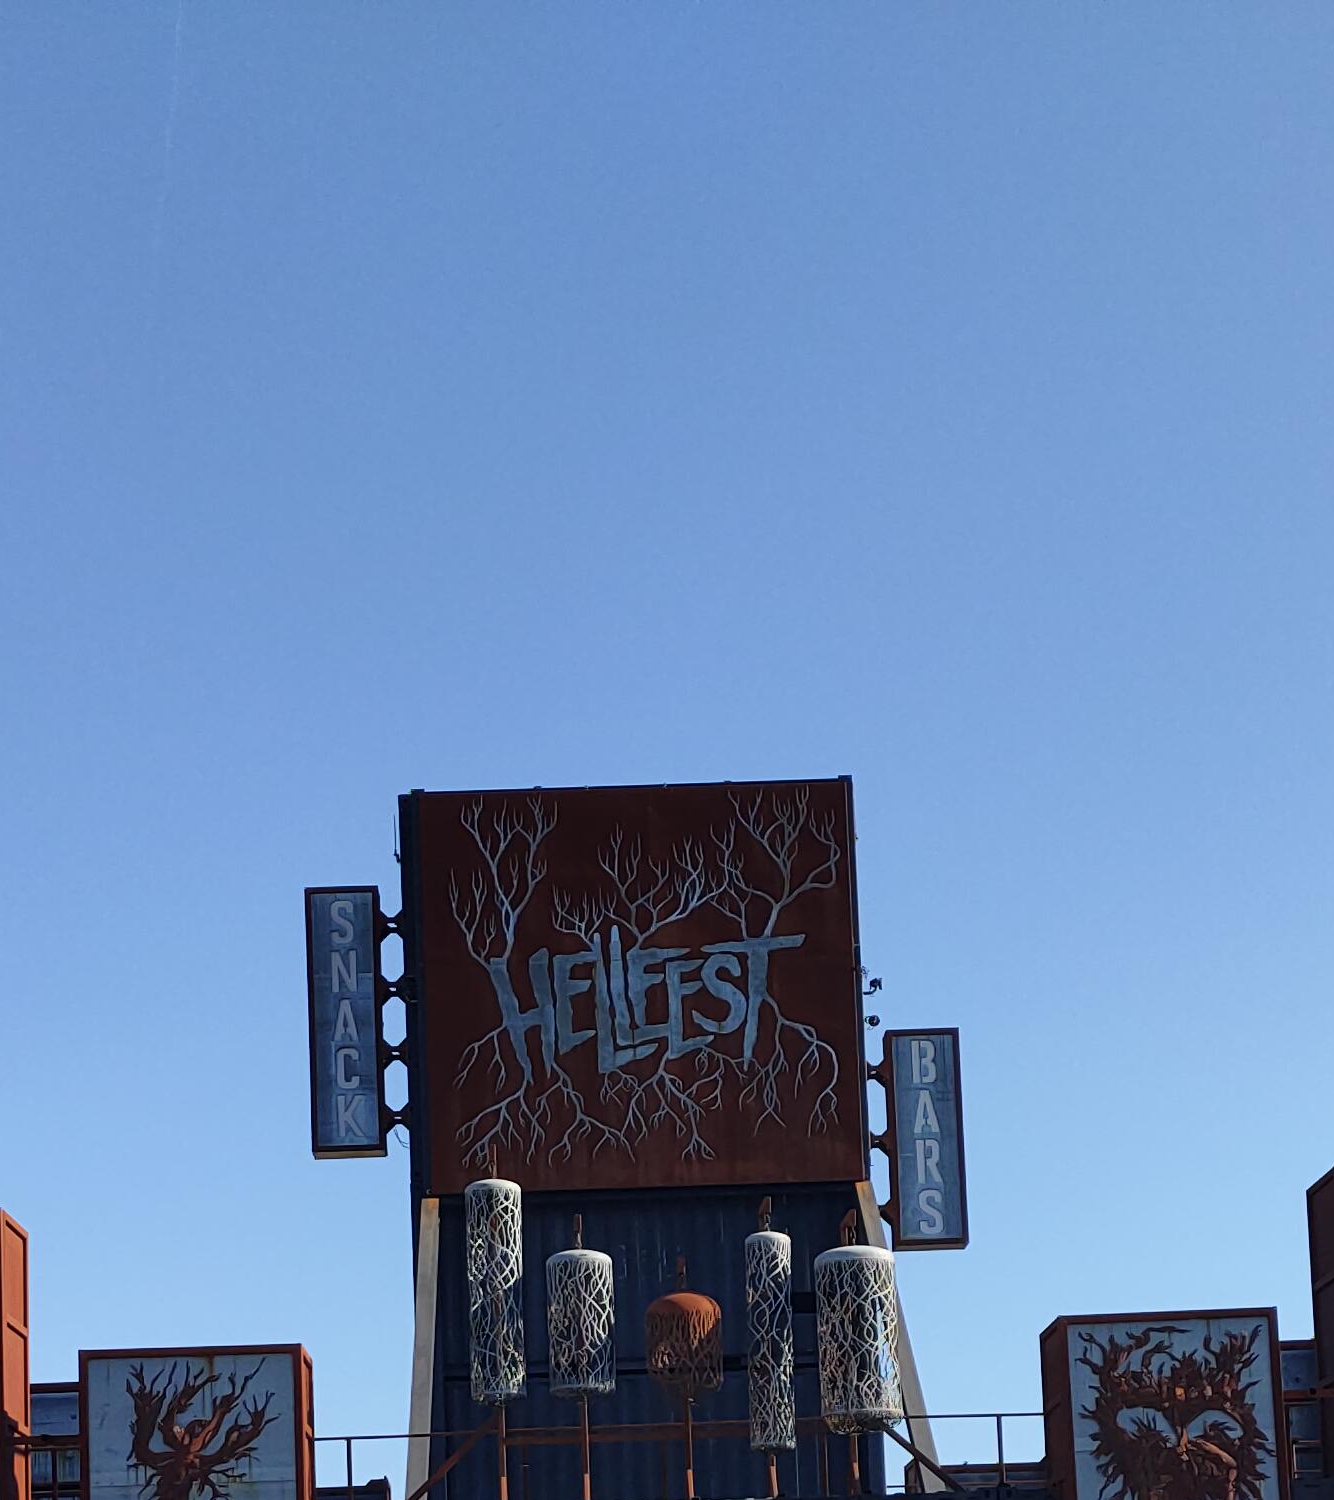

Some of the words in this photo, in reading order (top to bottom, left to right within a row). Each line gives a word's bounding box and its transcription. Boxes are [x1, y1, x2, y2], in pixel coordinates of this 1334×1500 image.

[330, 899, 366, 1138] SNACK
[489, 924, 807, 1087] HELLFEST
[910, 1039, 945, 1235] BARS
